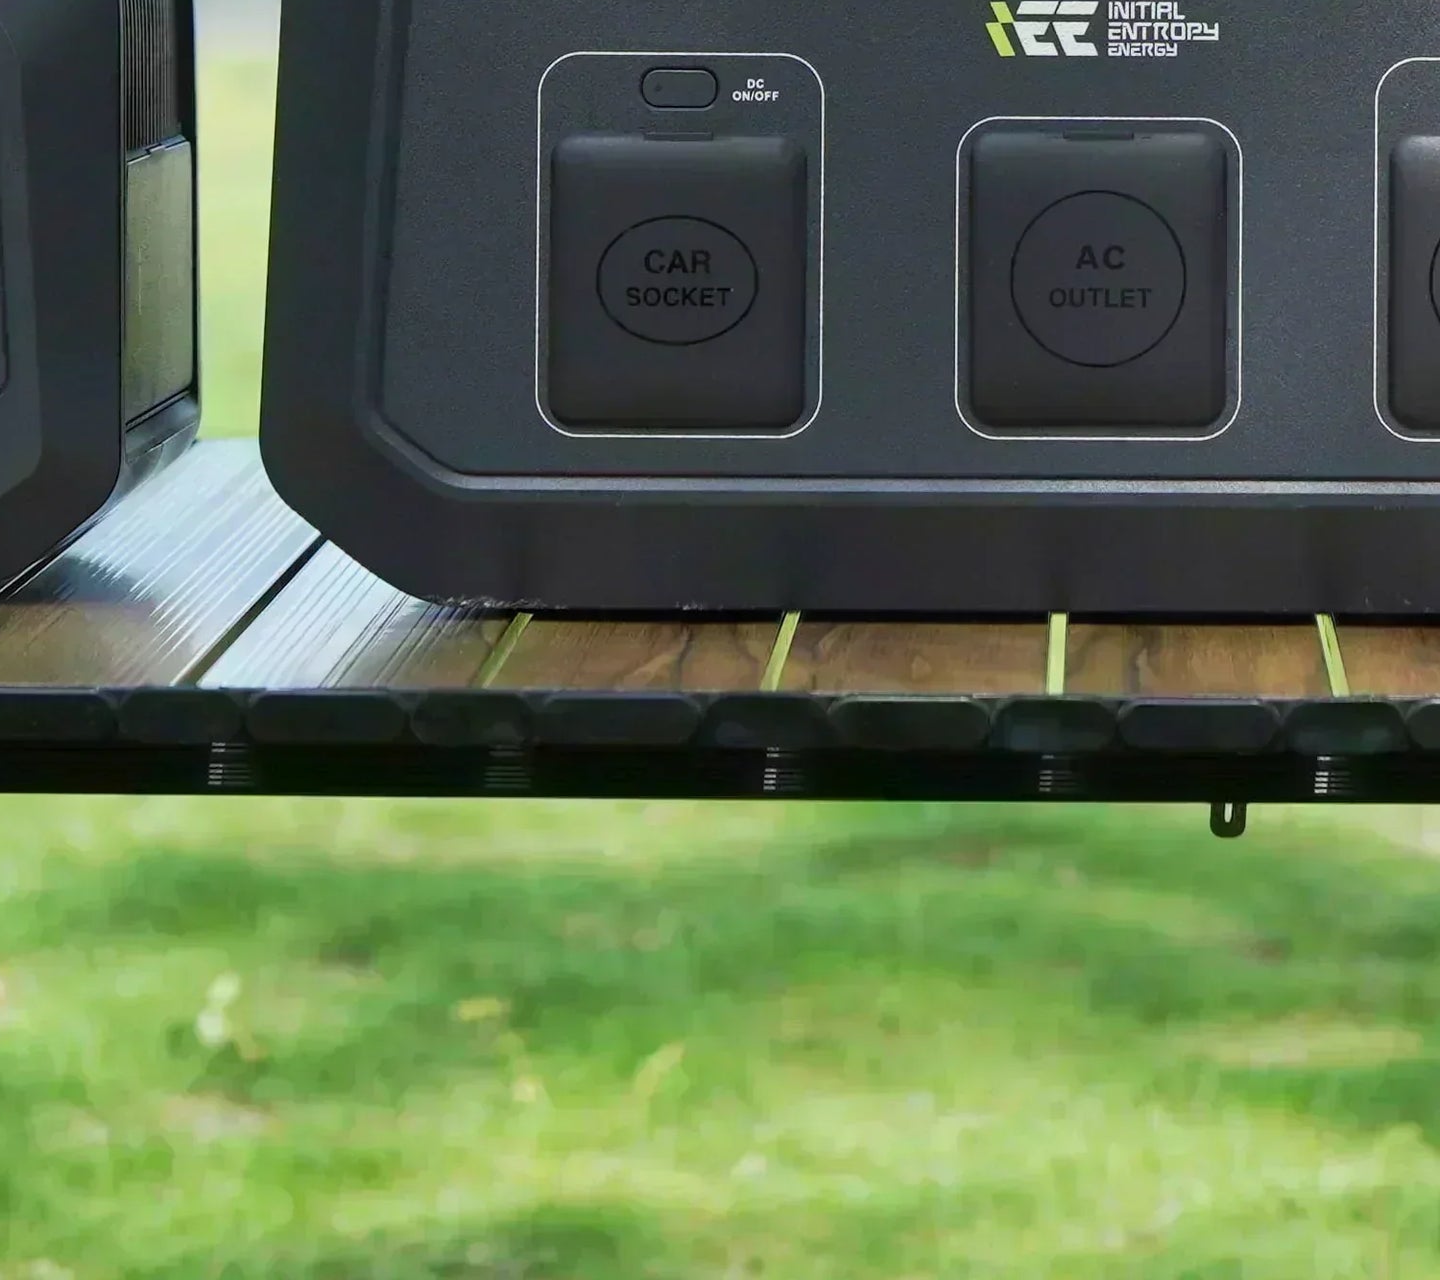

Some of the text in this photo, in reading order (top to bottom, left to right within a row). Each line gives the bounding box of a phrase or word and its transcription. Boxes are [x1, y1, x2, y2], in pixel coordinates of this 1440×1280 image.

[1108, 0, 1186, 21] INITIAL
[1107, 21, 1220, 41] ENTROPY
[1107, 42, 1178, 57] ENERGY
[746, 78, 765, 89] DC
[732, 90, 780, 102] ON/OFF
[643, 249, 712, 275] CAR
[1074, 244, 1126, 270] AC
[625, 286, 732, 308] SOCKET
[1047, 286, 1153, 309] OUTLET
